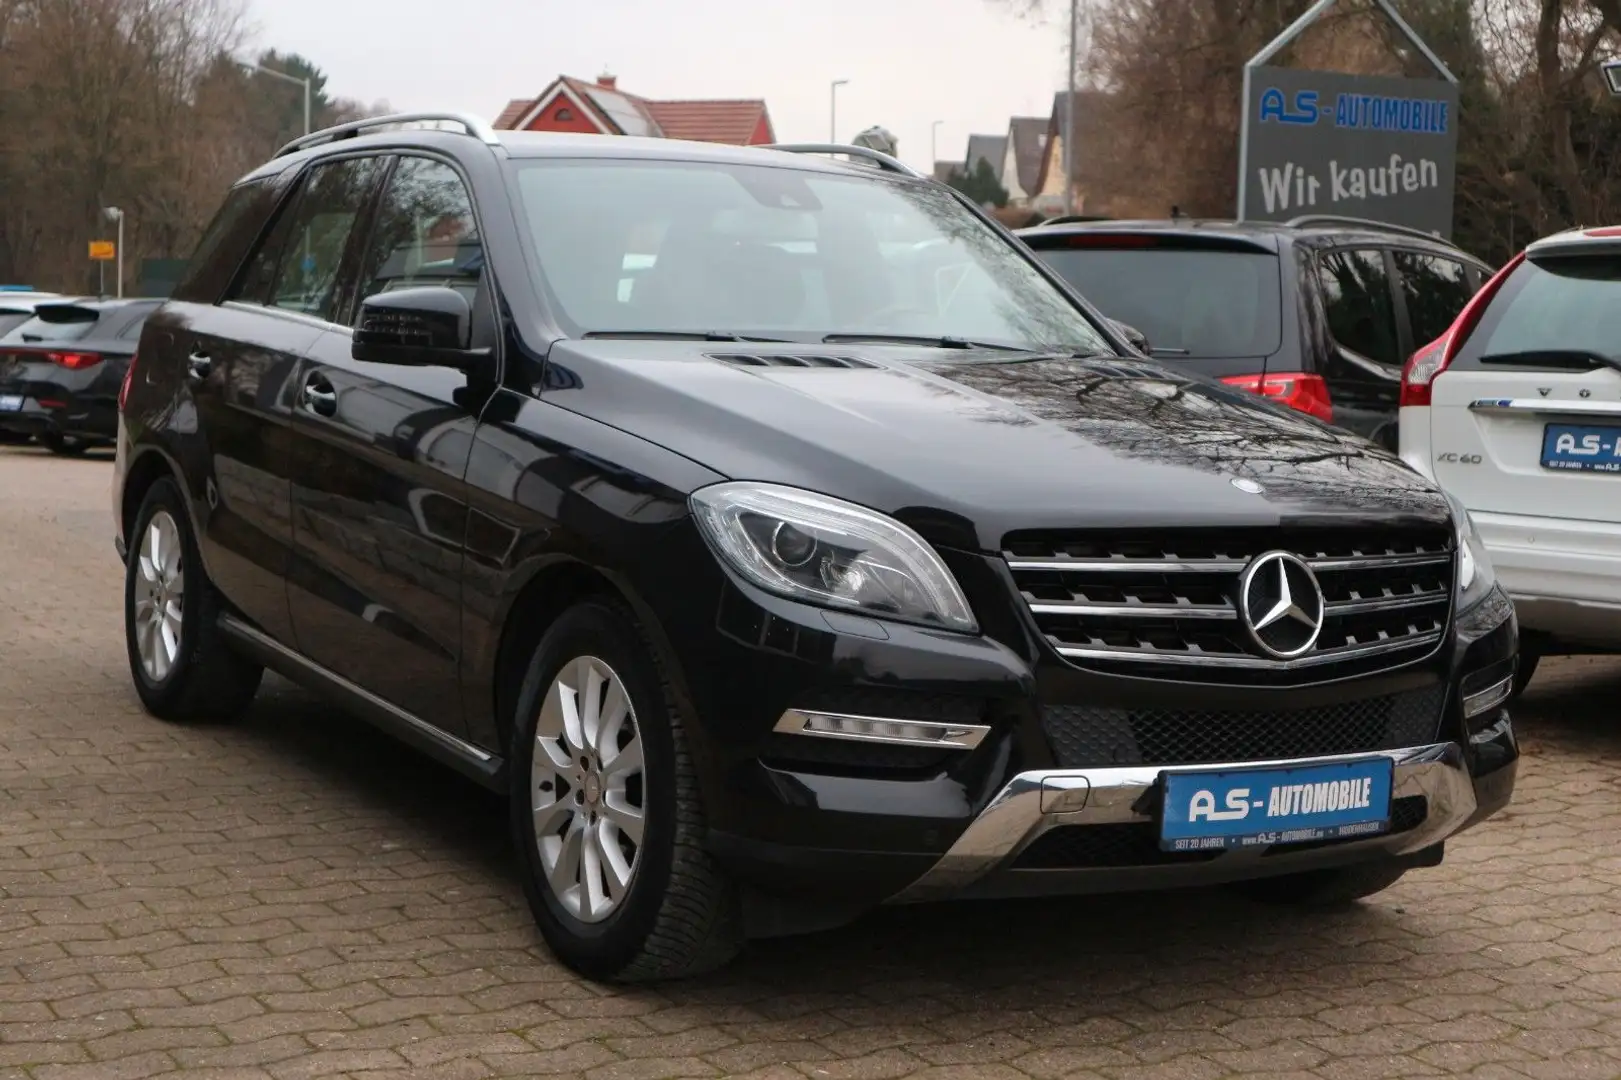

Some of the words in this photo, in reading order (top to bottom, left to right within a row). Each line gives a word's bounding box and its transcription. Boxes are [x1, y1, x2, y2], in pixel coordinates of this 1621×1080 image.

[1259, 161, 1321, 214] Wir
[1329, 153, 1438, 201] kaufen
[1175, 838, 1189, 849] SEIT
[1190, 838, 1199, 848] 20
[1200, 836, 1225, 848] JAHREN
